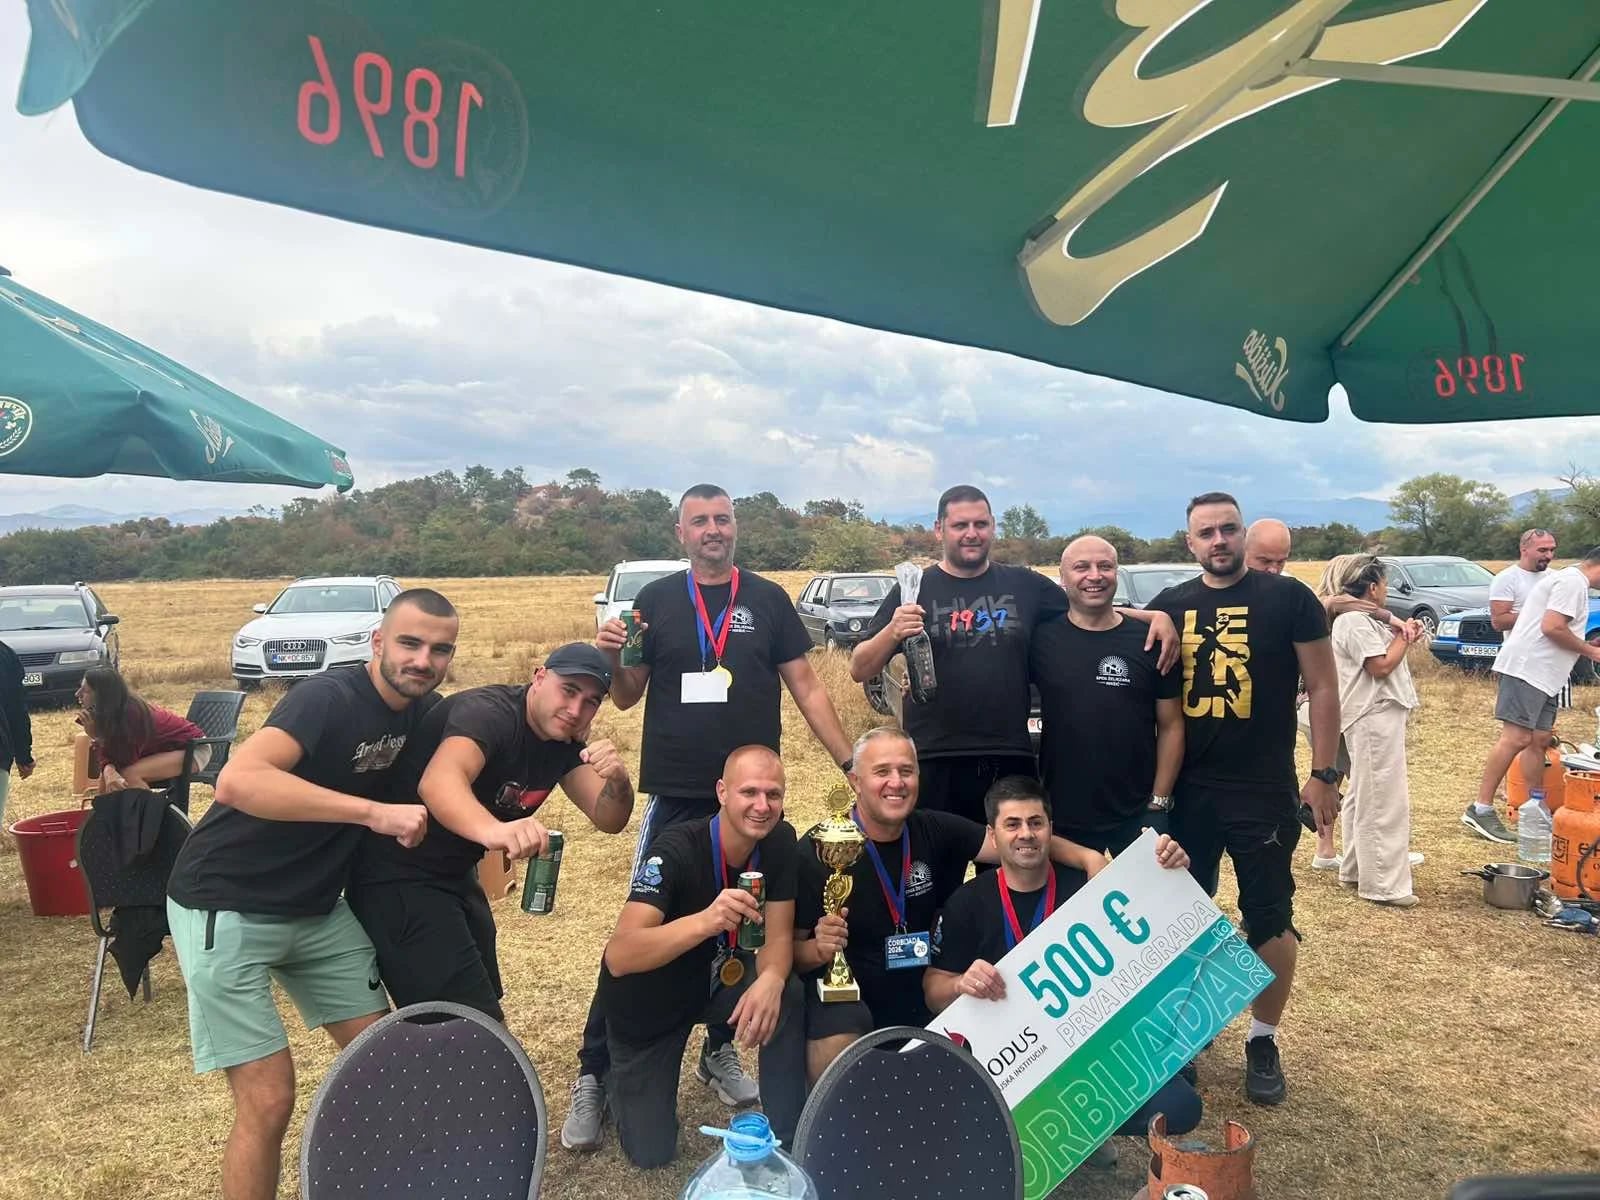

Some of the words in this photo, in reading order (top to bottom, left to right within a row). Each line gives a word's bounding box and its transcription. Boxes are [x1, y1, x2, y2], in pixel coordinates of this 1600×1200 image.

[950, 609, 1009, 633] 1957
[916, 944, 926, 953] 26
[1018, 922, 1115, 1019] 500
[1102, 890, 1150, 945] €
[1211, 920, 1272, 988] 2026
[1056, 987, 1120, 1049] PRVA
[1111, 900, 1217, 999] NAGRADA
[987, 1026, 1038, 1076] ODUS
[1013, 1044, 1049, 1078] INSTITUCIJA
